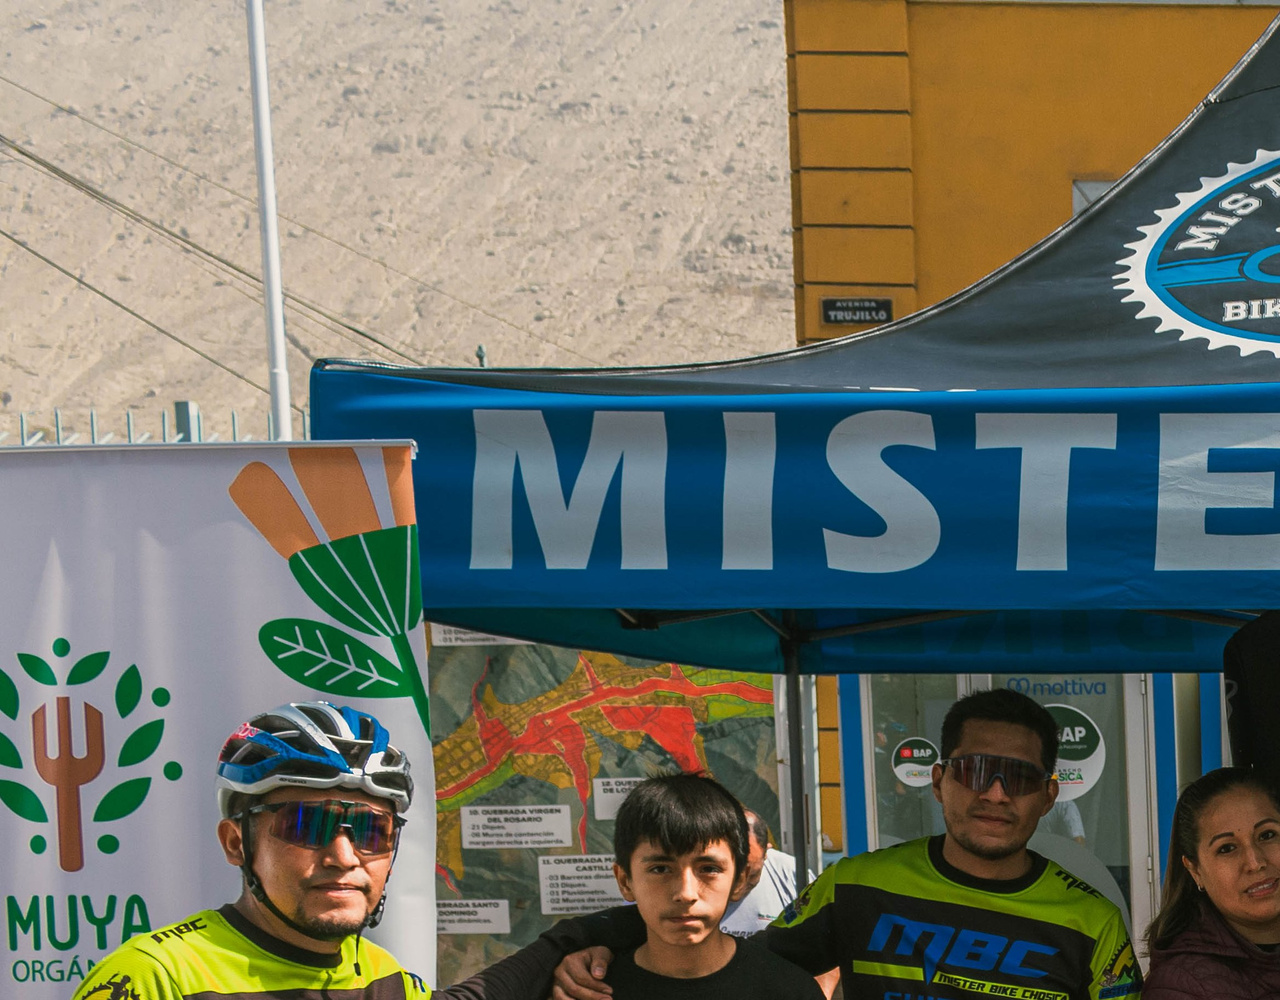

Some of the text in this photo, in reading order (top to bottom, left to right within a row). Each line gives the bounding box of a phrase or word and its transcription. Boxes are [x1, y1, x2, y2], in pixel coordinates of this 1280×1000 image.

[828, 310, 887, 320] TRUJILLO
[1033, 678, 1107, 696] mottiva
[1057, 726, 1087, 742] AP
[913, 749, 933, 757] BAP
[7, 893, 153, 952] MUYA
[937, 973, 986, 994] MISTER
[988, 983, 1019, 998] BIKE
